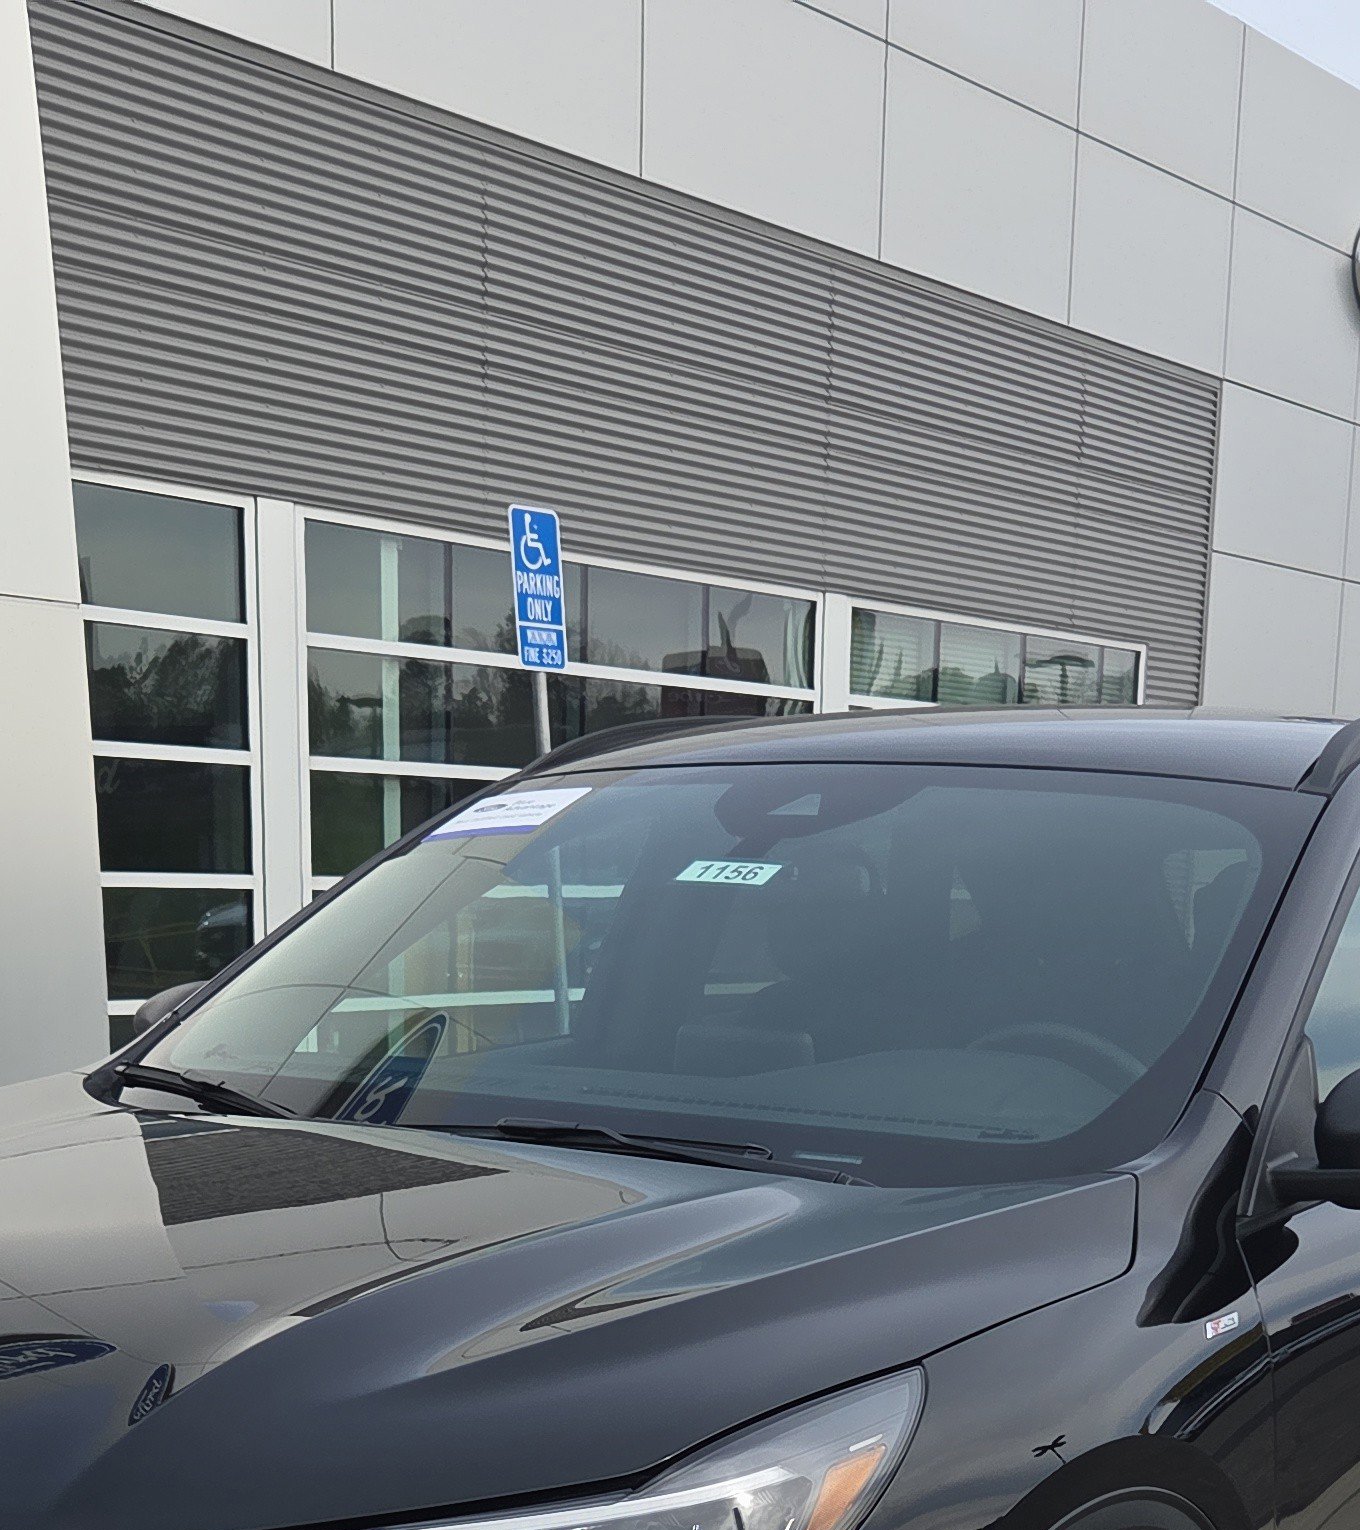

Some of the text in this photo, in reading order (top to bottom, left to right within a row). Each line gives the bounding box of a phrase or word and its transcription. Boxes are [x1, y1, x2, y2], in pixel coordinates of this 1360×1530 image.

[516, 570, 561, 599] PARKING
[526, 597, 553, 622] ONLY
[696, 863, 765, 881] 1156
